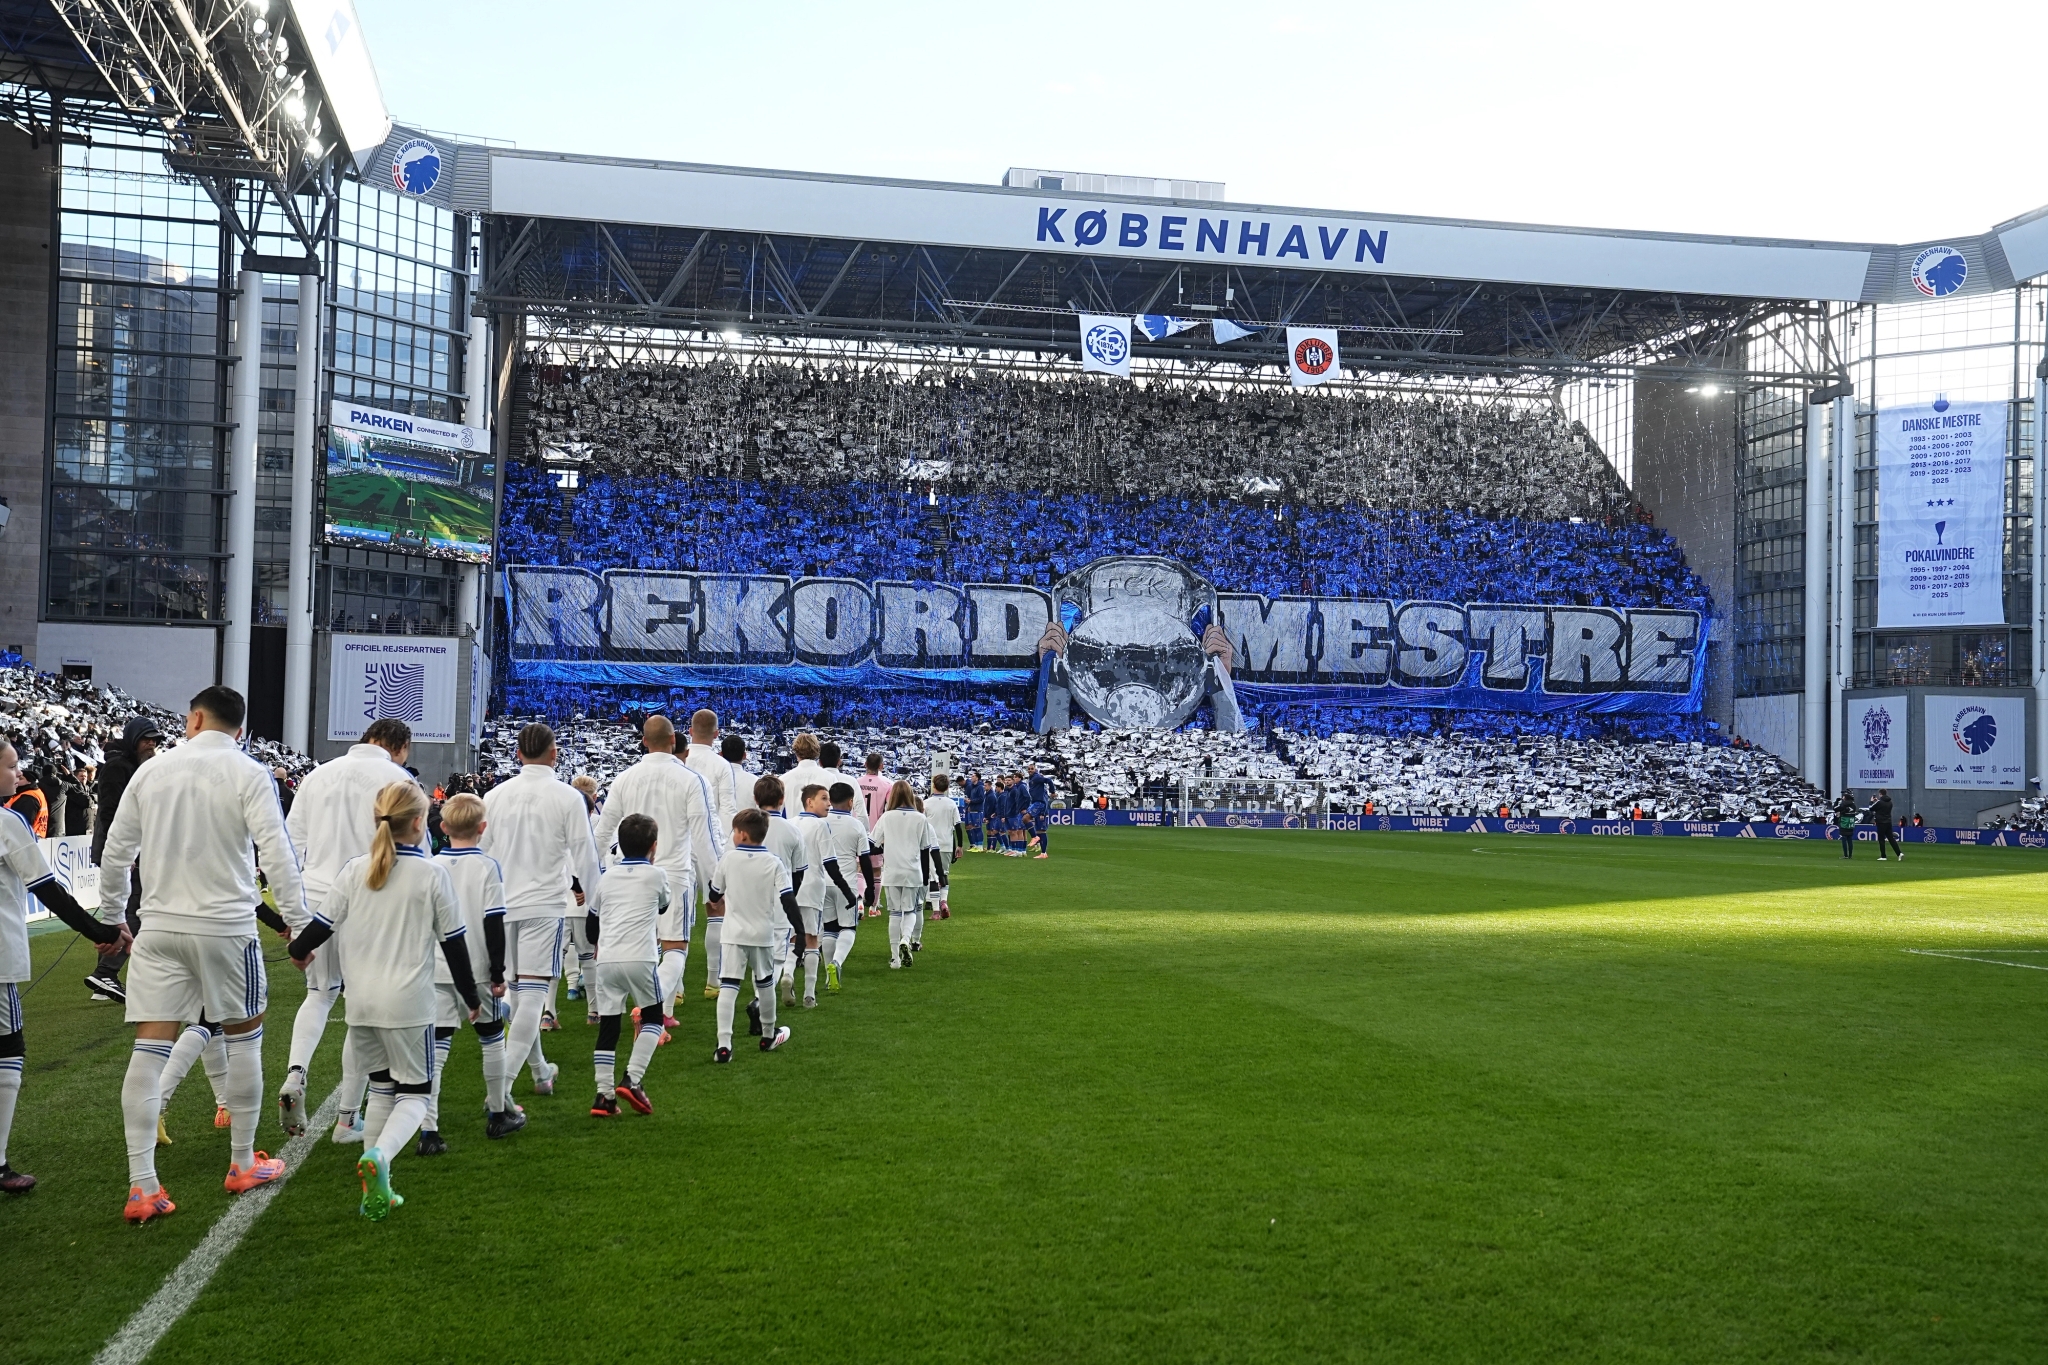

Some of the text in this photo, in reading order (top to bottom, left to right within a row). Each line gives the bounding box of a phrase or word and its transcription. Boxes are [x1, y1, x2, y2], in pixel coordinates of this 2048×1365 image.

[401, 140, 436, 154] KØBENHAVN
[1037, 206, 1388, 264] KØBENHAVN
[1915, 246, 1952, 266] KØBENHAVN
[1100, 340, 1114, 350] 1876
[1297, 339, 1333, 365] BOLDKLUBBEN
[350, 410, 413, 434] PARKEN
[417, 426, 450, 437] CONNECTED
[1902, 414, 1981, 432] DANSKE MESTRE
[1906, 548, 1974, 562] POKALVINDERE
[1103, 576, 1168, 602] FCK
[508, 566, 1051, 667] REKORD
[345, 644, 446, 653] OFFICIEL REJSEPARTNER
[1218, 594, 1700, 692] MESTRE
[364, 663, 378, 720] ALIVE
[1412, 818, 1449, 827] UNIBET
[1504, 819, 1540, 834] Carlsberg
[1592, 822, 1635, 836] andel
[1684, 823, 1720, 833] UNIBET
[1775, 825, 1809, 839] Carlsberg
[1956, 830, 1980, 839] UNIBET
[2019, 833, 2046, 847] Carlsberg
